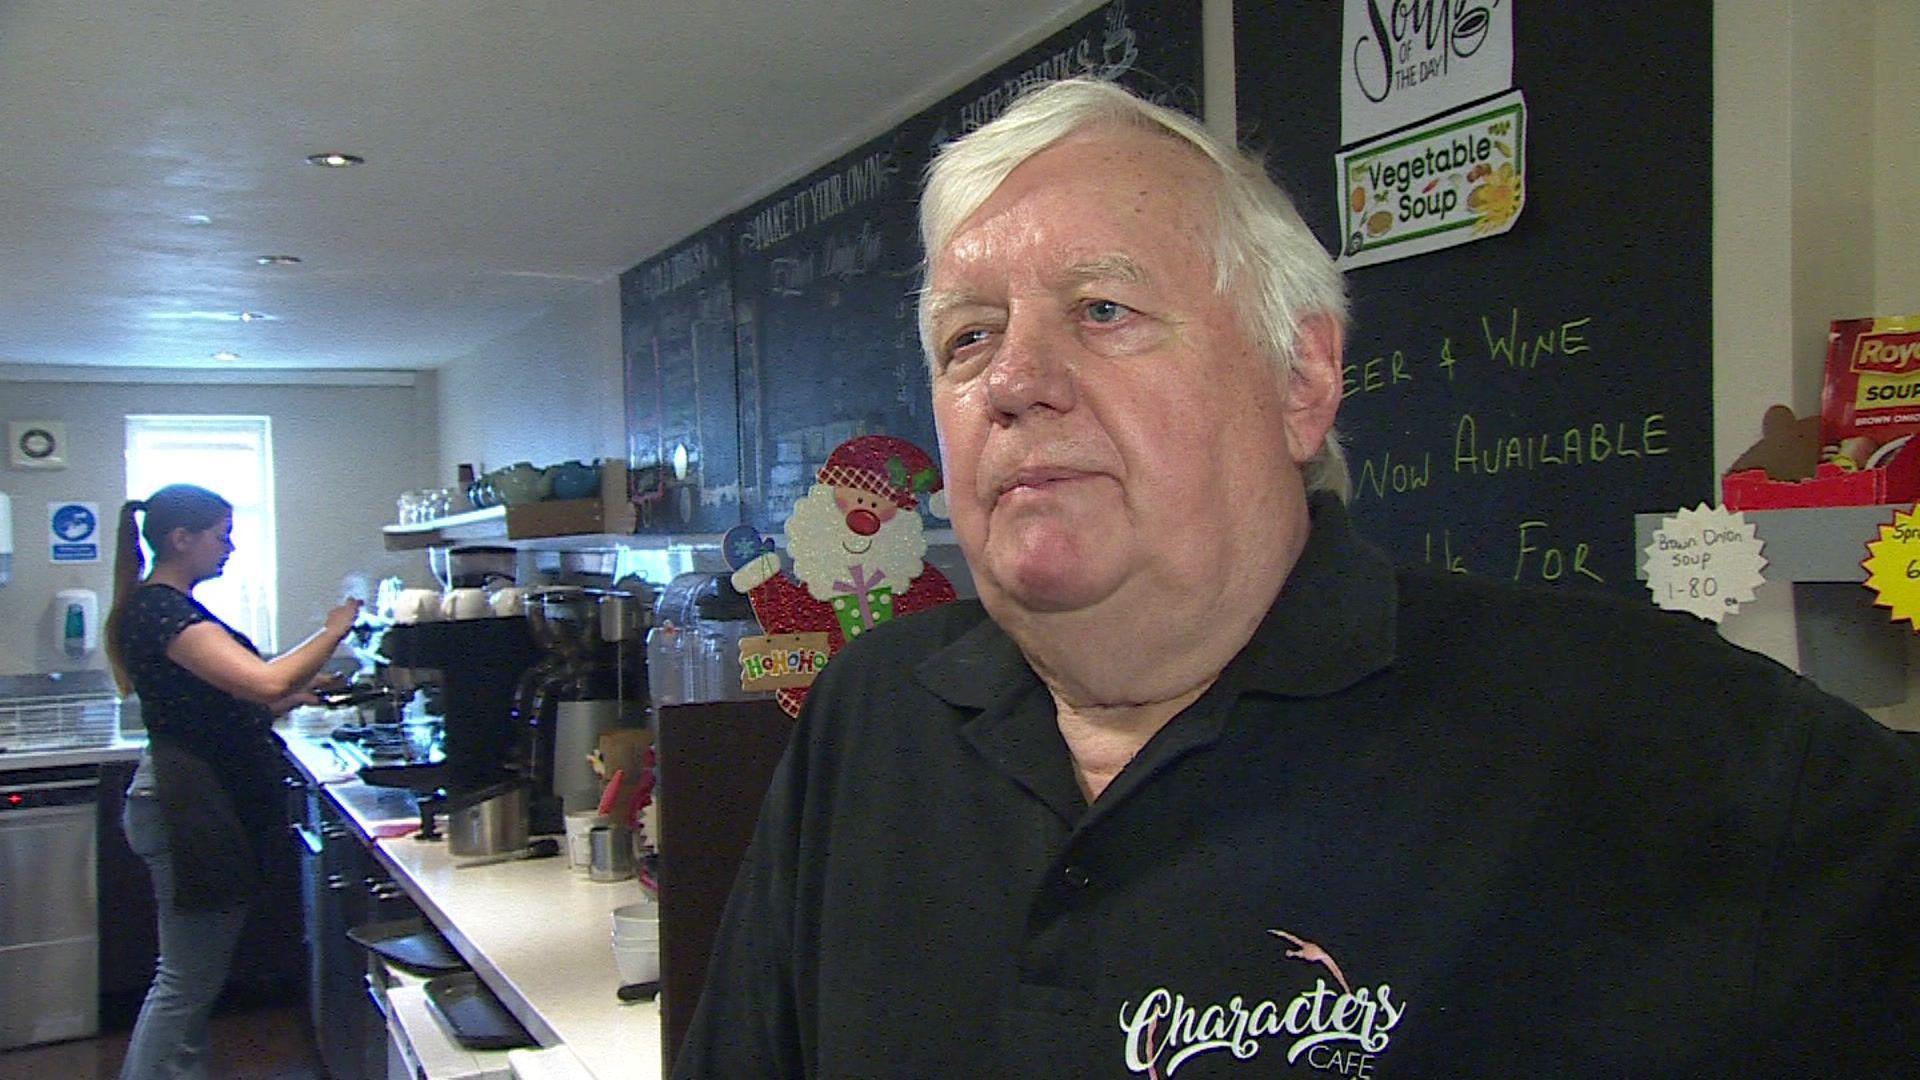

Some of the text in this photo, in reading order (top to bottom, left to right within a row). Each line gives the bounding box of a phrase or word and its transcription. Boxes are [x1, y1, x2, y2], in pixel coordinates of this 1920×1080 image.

[1400, 40, 1412, 63] OF
[1395, 55, 1443, 90] THE DAY
[1369, 134, 1491, 192] Vegetable
[1399, 188, 1457, 222] Soup
[1342, 351, 1412, 398] EER
[1866, 383, 1920, 401] SOUP
[1855, 416, 1892, 426] BROWN
[1703, 528, 1743, 546] Onion
[1892, 523, 1920, 544] Spr
[1119, 978, 1406, 1077] Characters
[1308, 1045, 1375, 1080] CAFE
